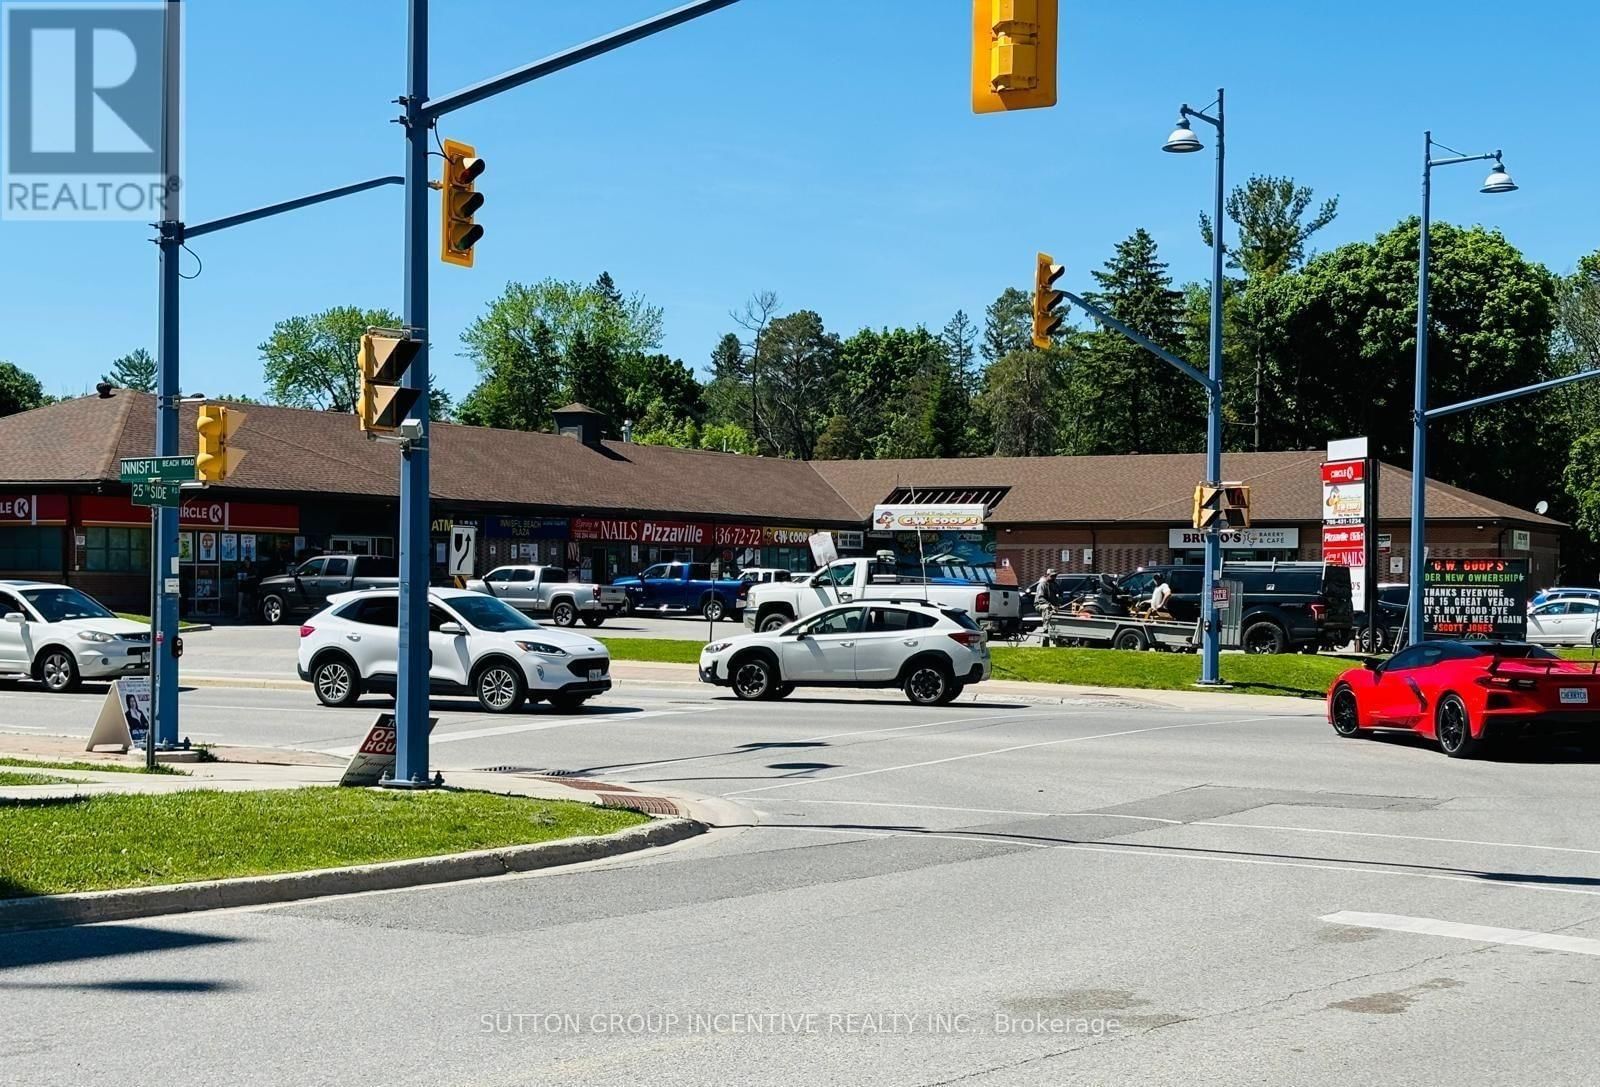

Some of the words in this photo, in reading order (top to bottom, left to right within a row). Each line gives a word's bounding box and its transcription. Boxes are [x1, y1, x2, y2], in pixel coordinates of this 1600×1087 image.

[121, 460, 161, 475] INNISFIL
[133, 484, 144, 497] 25
[150, 486, 167, 500] SIDE
[179, 507, 208, 518] IRCLE
[431, 520, 454, 532] ATM
[600, 520, 639, 541] NAILS
[512, 528, 530, 536] PLAZA
[641, 522, 704, 543] Pizzaville
[1182, 533, 1242, 544] BRUO'S
[1341, 551, 1364, 566] NAILS
[1424, 573, 1441, 582] DER
[1445, 573, 1465, 582] NEW
[1424, 588, 1457, 597] THANKS
[1460, 588, 1505, 598] EVERYONE
[1424, 597, 1434, 606] OR
[1440, 597, 1449, 606] 15
[1454, 597, 1481, 606] GREAT
[1488, 598, 1515, 607] YEARS
[1443, 606, 1461, 615] NOT
[1433, 615, 1451, 624] TILL
[1455, 615, 1468, 624] WE
[1472, 615, 1494, 624] MEET
[1497, 615, 1522, 624] AGAIN
[1467, 624, 1494, 632] JONES
[371, 729, 396, 742] OP
[364, 740, 397, 753] HOU
